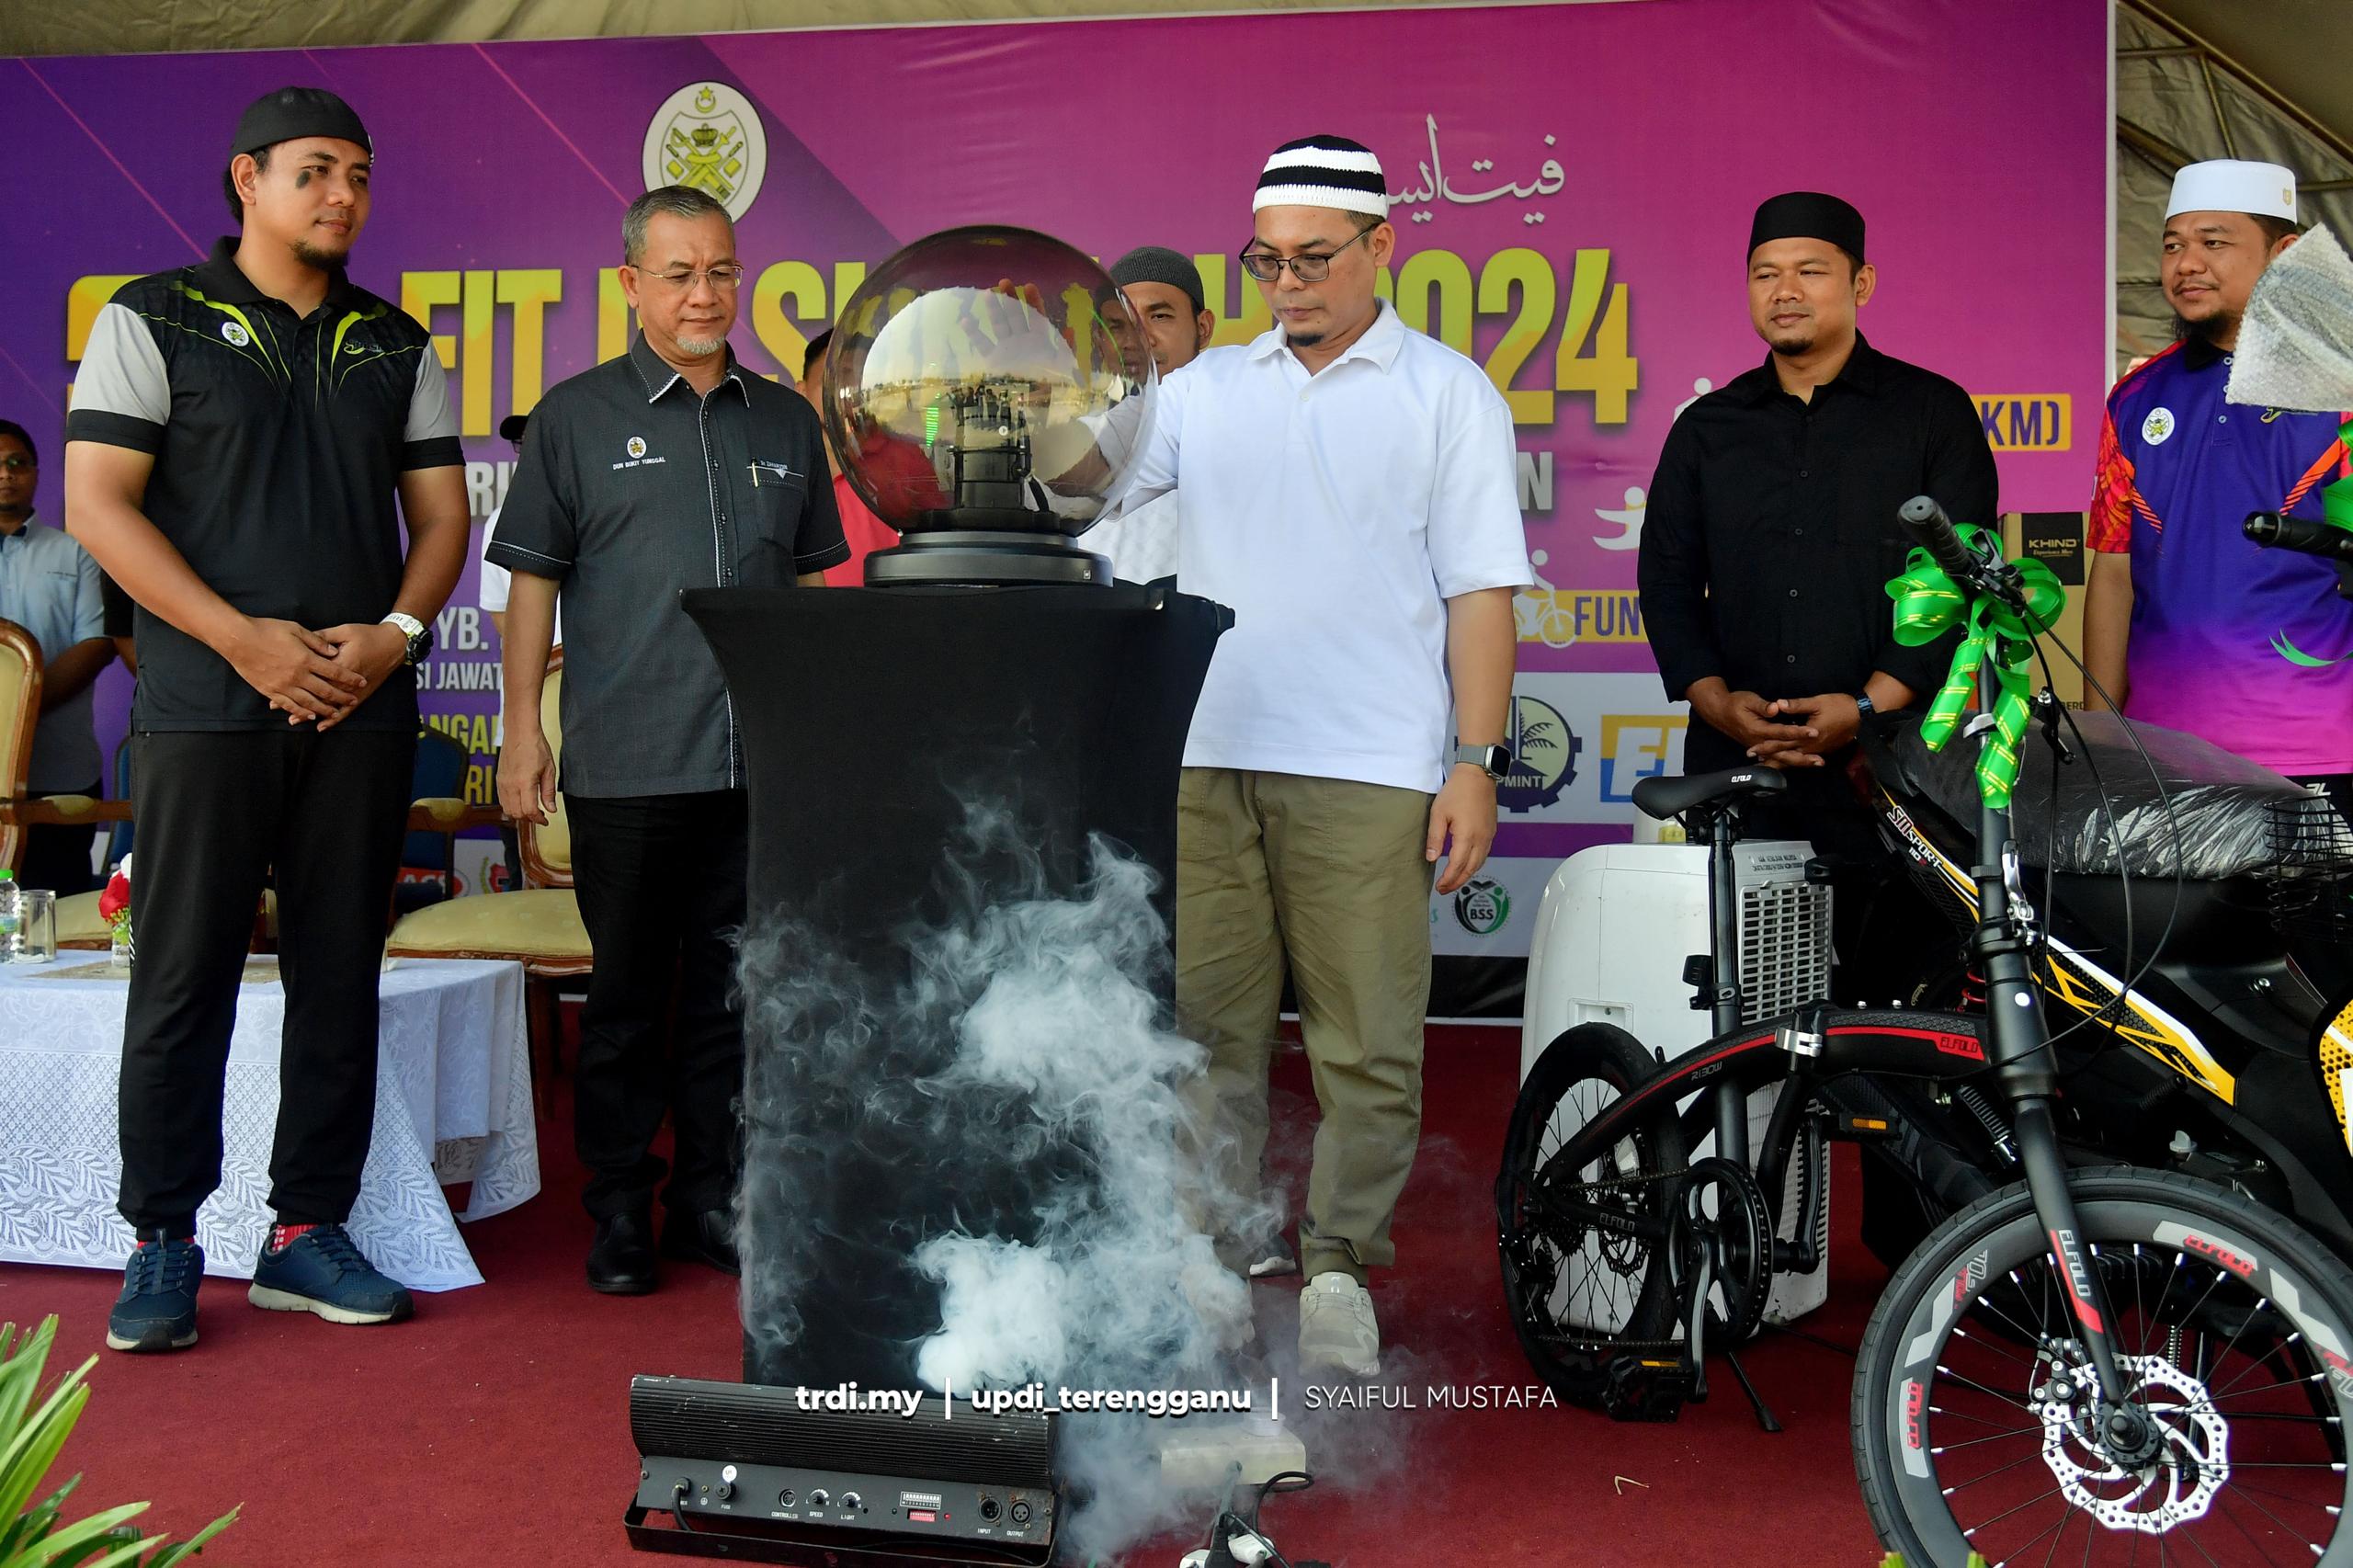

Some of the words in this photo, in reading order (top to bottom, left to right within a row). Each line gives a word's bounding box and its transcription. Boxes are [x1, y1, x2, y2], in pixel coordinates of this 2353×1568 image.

[2029, 539, 2077, 549] KHIND
[1574, 596, 1640, 636] FUN
[1471, 908, 1495, 921] BSS
[771, 1511, 799, 1519] CONTROLLER
